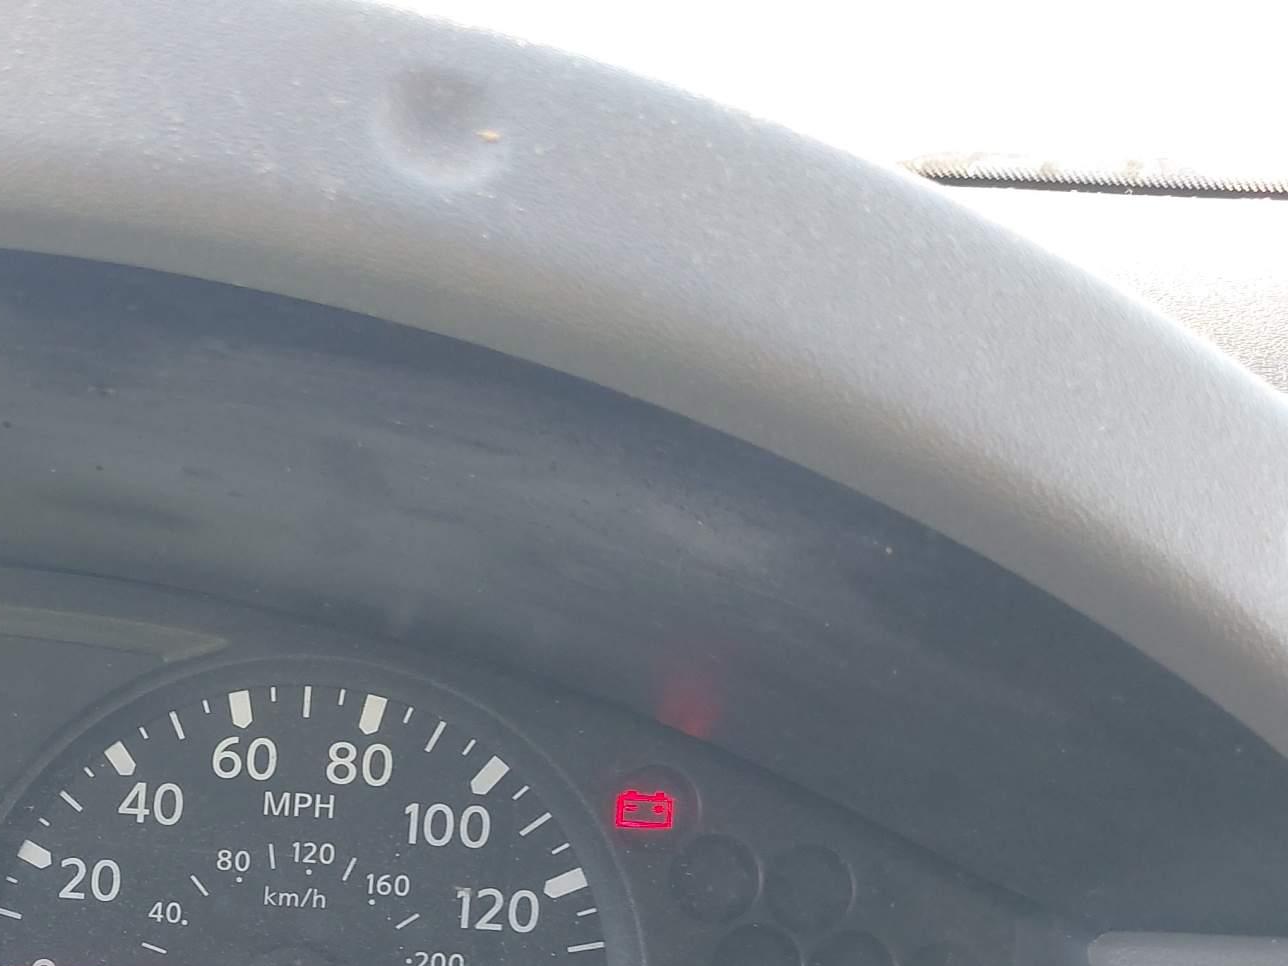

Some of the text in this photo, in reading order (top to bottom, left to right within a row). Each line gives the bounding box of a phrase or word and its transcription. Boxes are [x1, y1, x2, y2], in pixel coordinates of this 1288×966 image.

[213, 737, 276, 780] 60
[327, 742, 392, 786] 80
[119, 783, 183, 825] 40
[264, 792, 334, 818] MPH
[405, 803, 490, 848] 100
[217, 850, 250, 871] 80
[293, 842, 334, 864] 120
[59, 858, 120, 901] 20
[367, 874, 409, 896] 160
[149, 902, 181, 923] 40
[264, 886, 325, 908] km/h
[457, 887, 540, 932] 120
